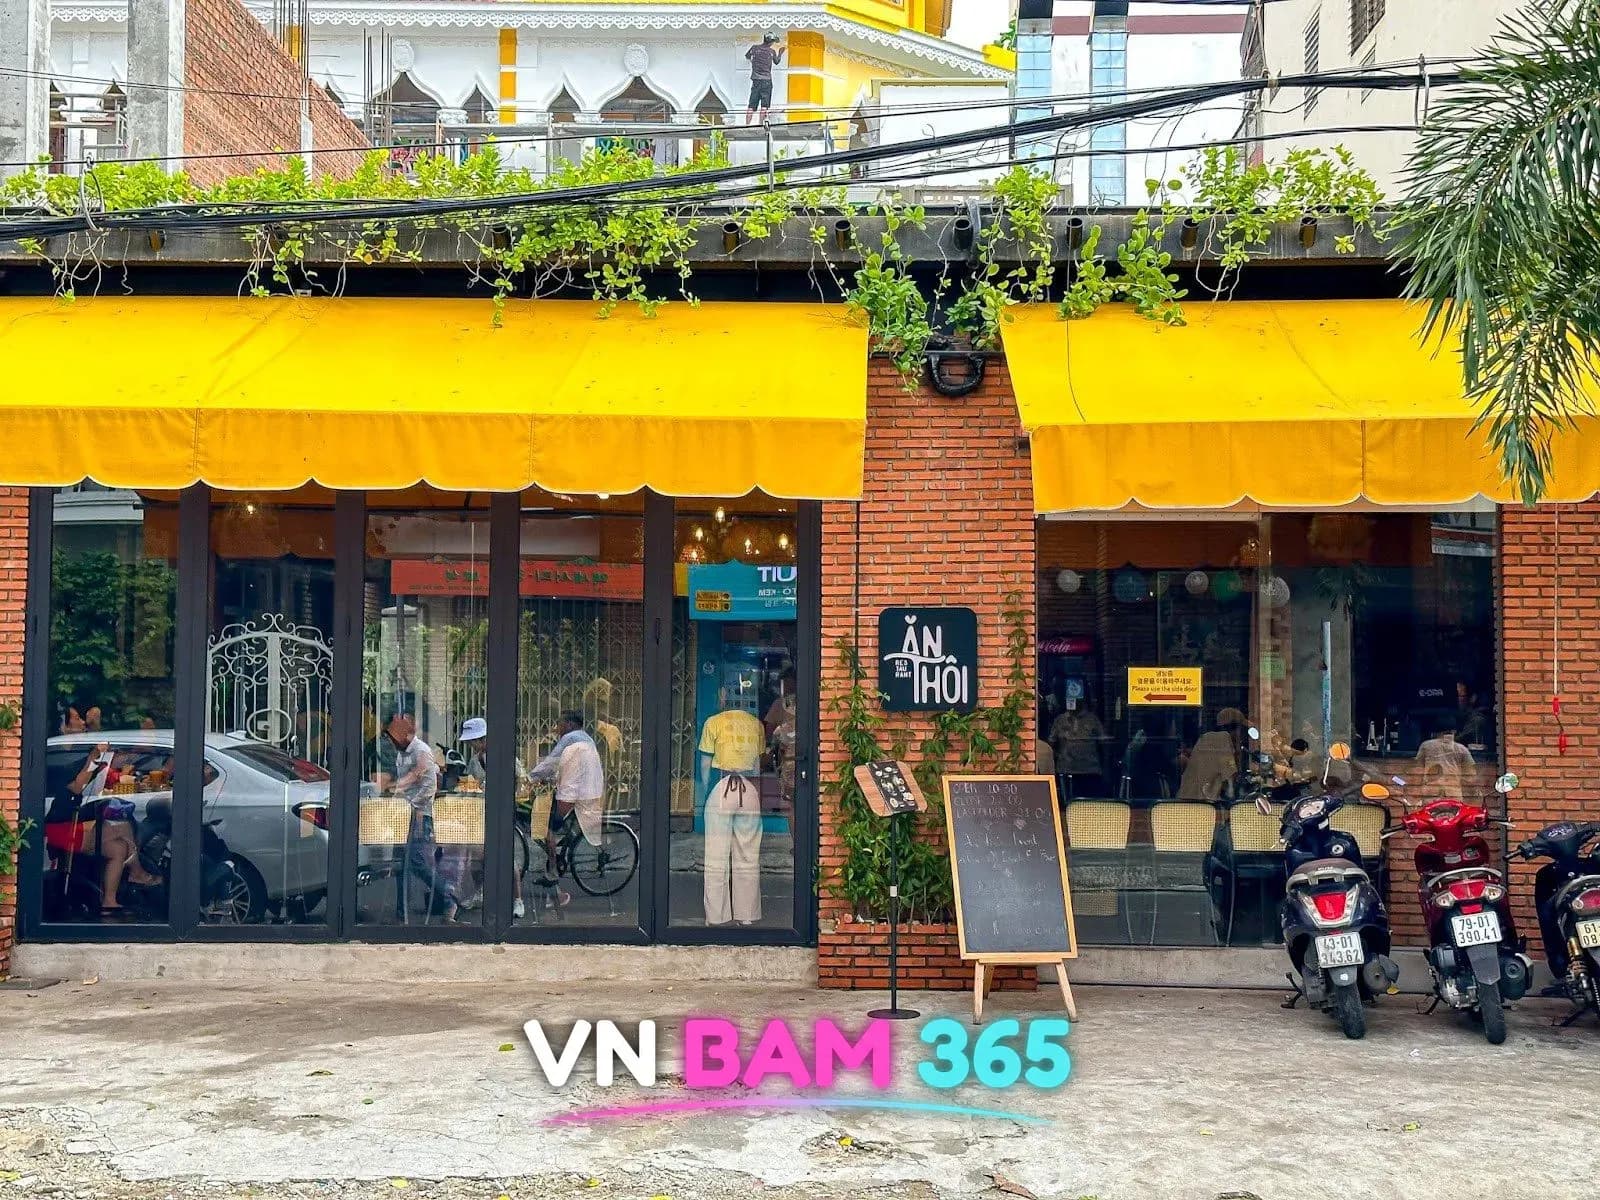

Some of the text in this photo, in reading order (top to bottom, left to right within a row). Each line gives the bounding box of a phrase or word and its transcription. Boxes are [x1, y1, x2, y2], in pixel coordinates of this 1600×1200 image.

[902, 615, 942, 657] ĂN
[883, 653, 968, 704] THÔI
[1458, 927, 1498, 944] 390.41
[1321, 949, 1361, 965] 343.62
